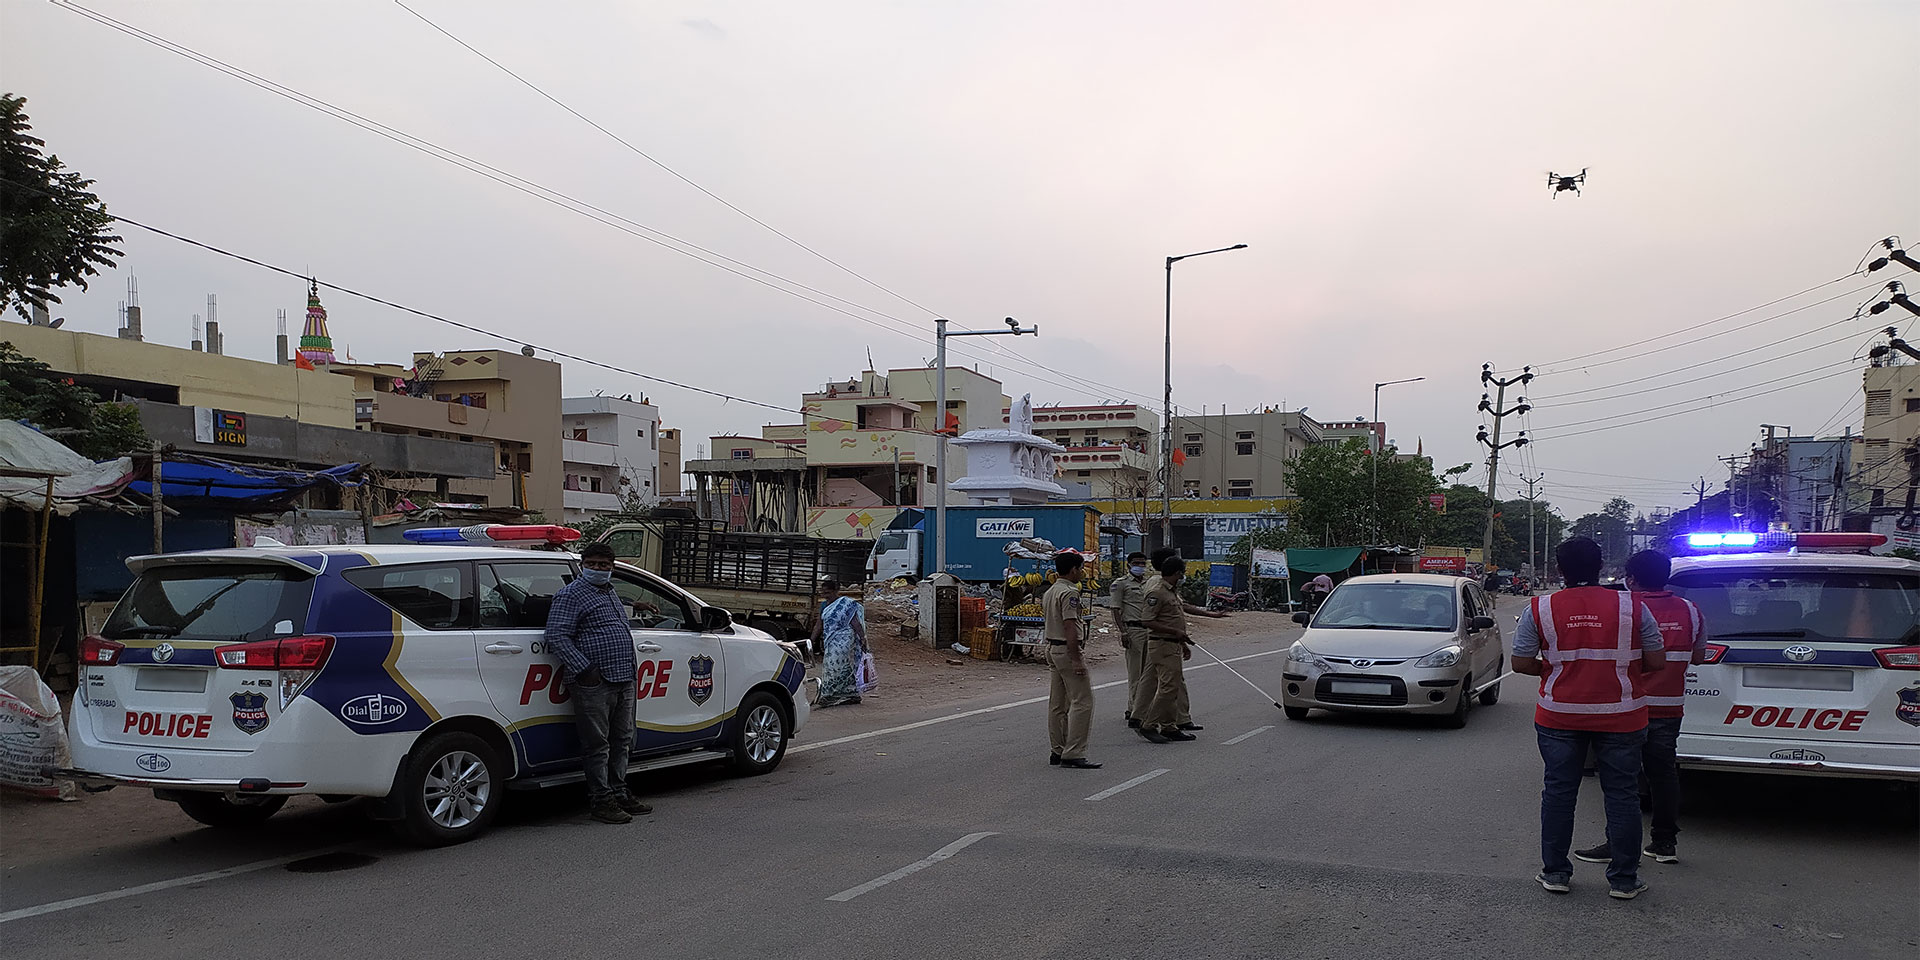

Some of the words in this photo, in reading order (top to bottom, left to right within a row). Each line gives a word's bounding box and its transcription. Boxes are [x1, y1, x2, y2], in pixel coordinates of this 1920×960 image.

[218, 431, 246, 444] SIGN
[691, 679, 712, 688] POLICE
[235, 711, 267, 719] POLICE
[348, 705, 368, 716] Dial
[383, 704, 402, 715] 100
[1723, 705, 1870, 732] POLICE
[123, 711, 214, 739] POLICE
[157, 760, 168, 768] 100
